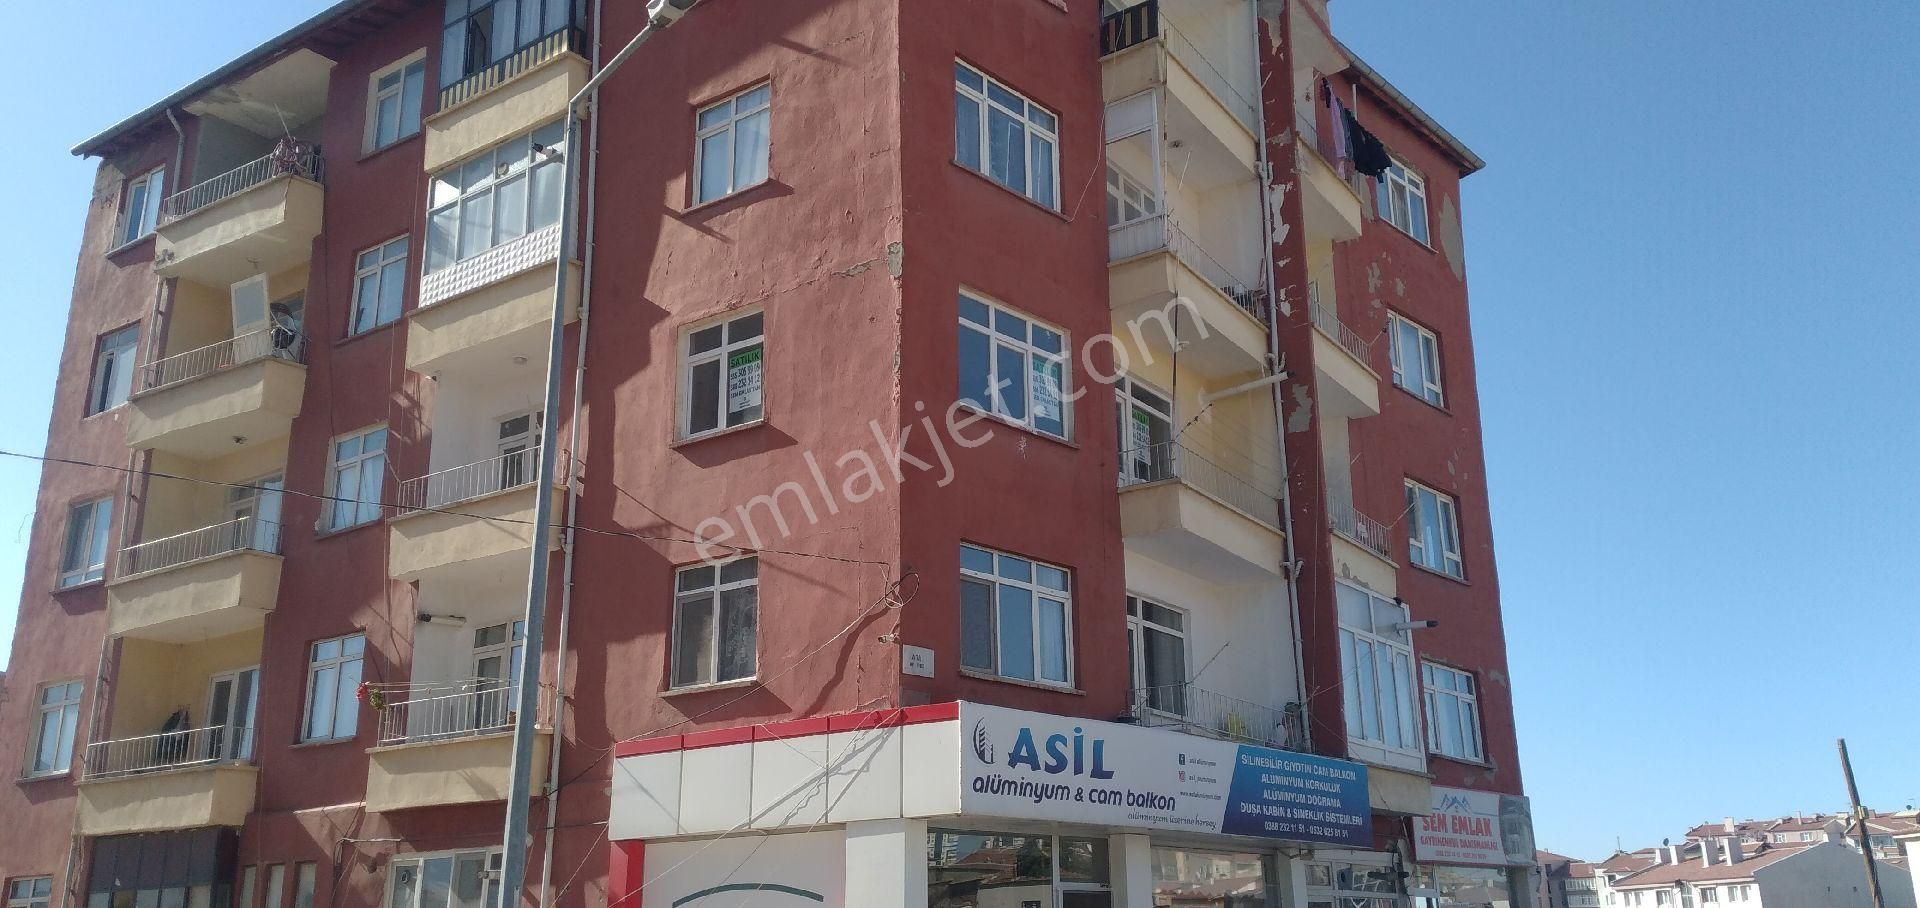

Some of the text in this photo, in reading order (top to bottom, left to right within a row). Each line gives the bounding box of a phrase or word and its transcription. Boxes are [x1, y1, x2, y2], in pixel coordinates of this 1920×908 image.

[730, 351, 761, 369] SATILIK
[1007, 727, 1115, 780] ASİL
[1313, 764, 1329, 777] CAM
[1330, 767, 1356, 781] BALKON
[972, 774, 1070, 804] alüminyum
[1074, 786, 1084, 803] &
[1088, 788, 1122, 807] cam
[1127, 789, 1176, 812] balkon
[1305, 780, 1341, 794] KORKULUK
[1240, 802, 1262, 817] DUŞA
[1263, 803, 1285, 817] KABİN
[1286, 807, 1292, 818] &
[1421, 813, 1492, 837] SEM EMLAK
